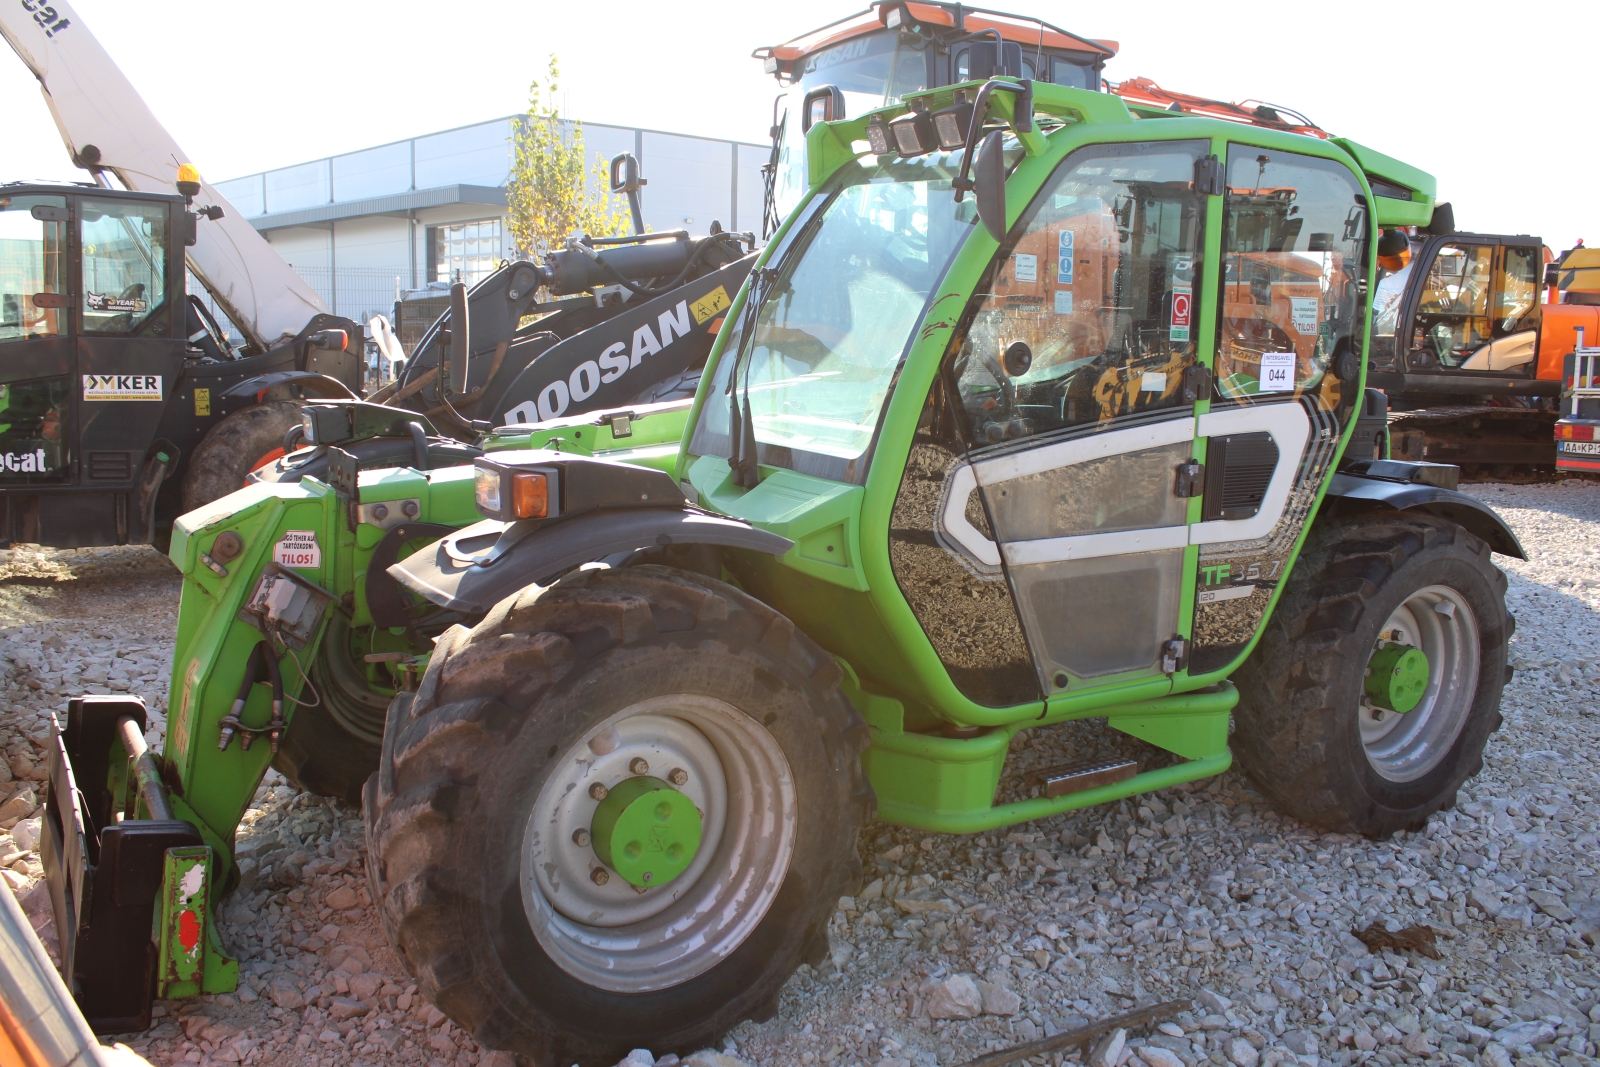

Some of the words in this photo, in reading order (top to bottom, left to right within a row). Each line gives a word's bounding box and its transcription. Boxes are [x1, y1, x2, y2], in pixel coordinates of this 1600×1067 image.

[108, 296, 116, 305] 3
[1297, 323, 1316, 332] TILOS!
[504, 299, 692, 426] DOOSAN
[1269, 369, 1286, 381] 044
[281, 553, 314, 564] TILOS!
[1201, 564, 1231, 586] TF
[1234, 560, 1281, 581] 35.7
[1200, 592, 1215, 601] 120
